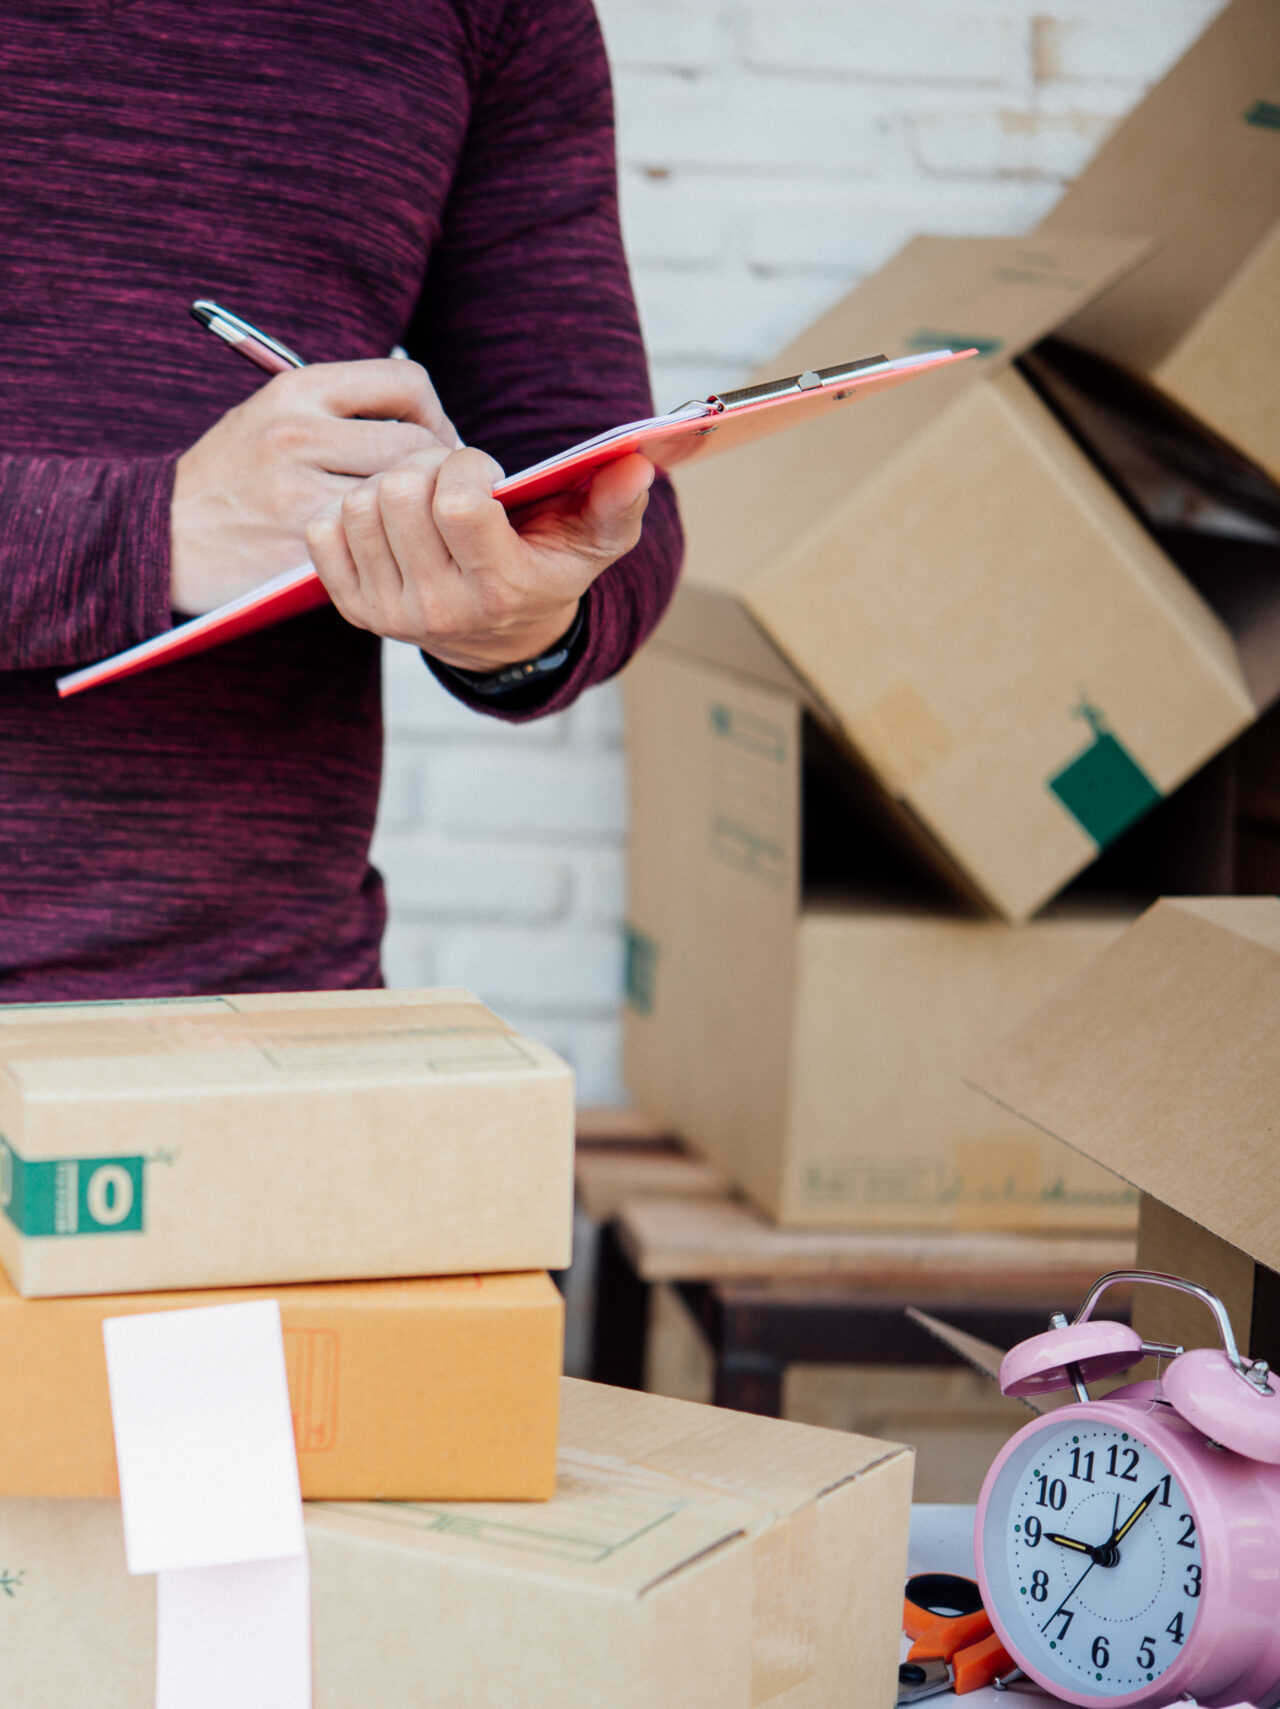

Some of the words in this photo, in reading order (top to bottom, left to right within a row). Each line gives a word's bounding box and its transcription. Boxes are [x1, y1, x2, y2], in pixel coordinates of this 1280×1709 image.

[1069, 1447, 1095, 1483] 11
[1106, 1444, 1140, 1482] 12
[1036, 1475, 1067, 1511] 10
[1159, 1475, 1172, 1507] 1
[1025, 1516, 1041, 1548] 9
[1178, 1514, 1196, 1548] 2
[1031, 1570, 1049, 1602] 8
[1183, 1564, 1201, 1598] 3
[1057, 1608, 1074, 1641] 7
[1166, 1611, 1184, 1645] 4
[1091, 1636, 1109, 1668] 6
[1137, 1636, 1157, 1668] 5
